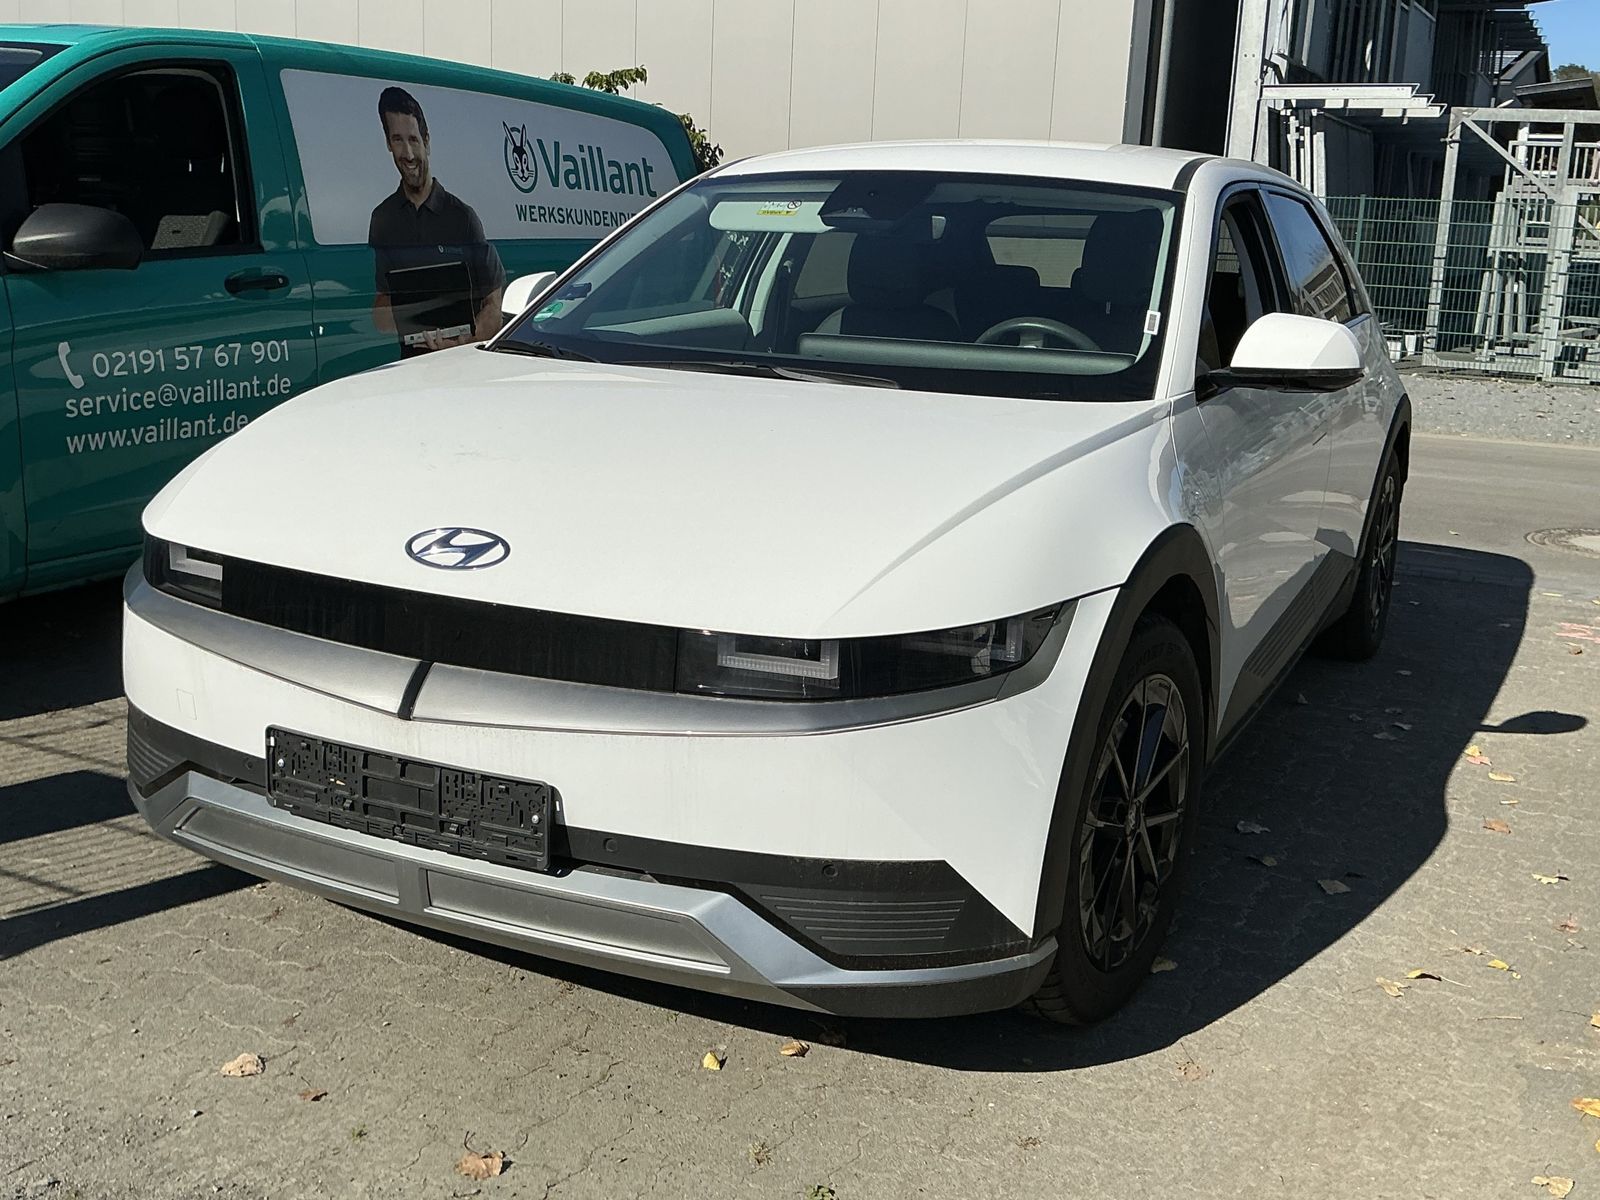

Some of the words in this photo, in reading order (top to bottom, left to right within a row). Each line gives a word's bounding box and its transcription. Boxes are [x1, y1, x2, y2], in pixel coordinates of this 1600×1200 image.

[537, 139, 657, 197] Vaillant
[516, 204, 637, 227] WERKSKUNDEND
[92, 349, 166, 378] 02191
[174, 345, 203, 370] 57
[214, 342, 242, 368] 67
[251, 340, 289, 364] 901
[65, 373, 291, 418] service@vaillant.de
[66, 411, 248, 454] www.vaillant.de
